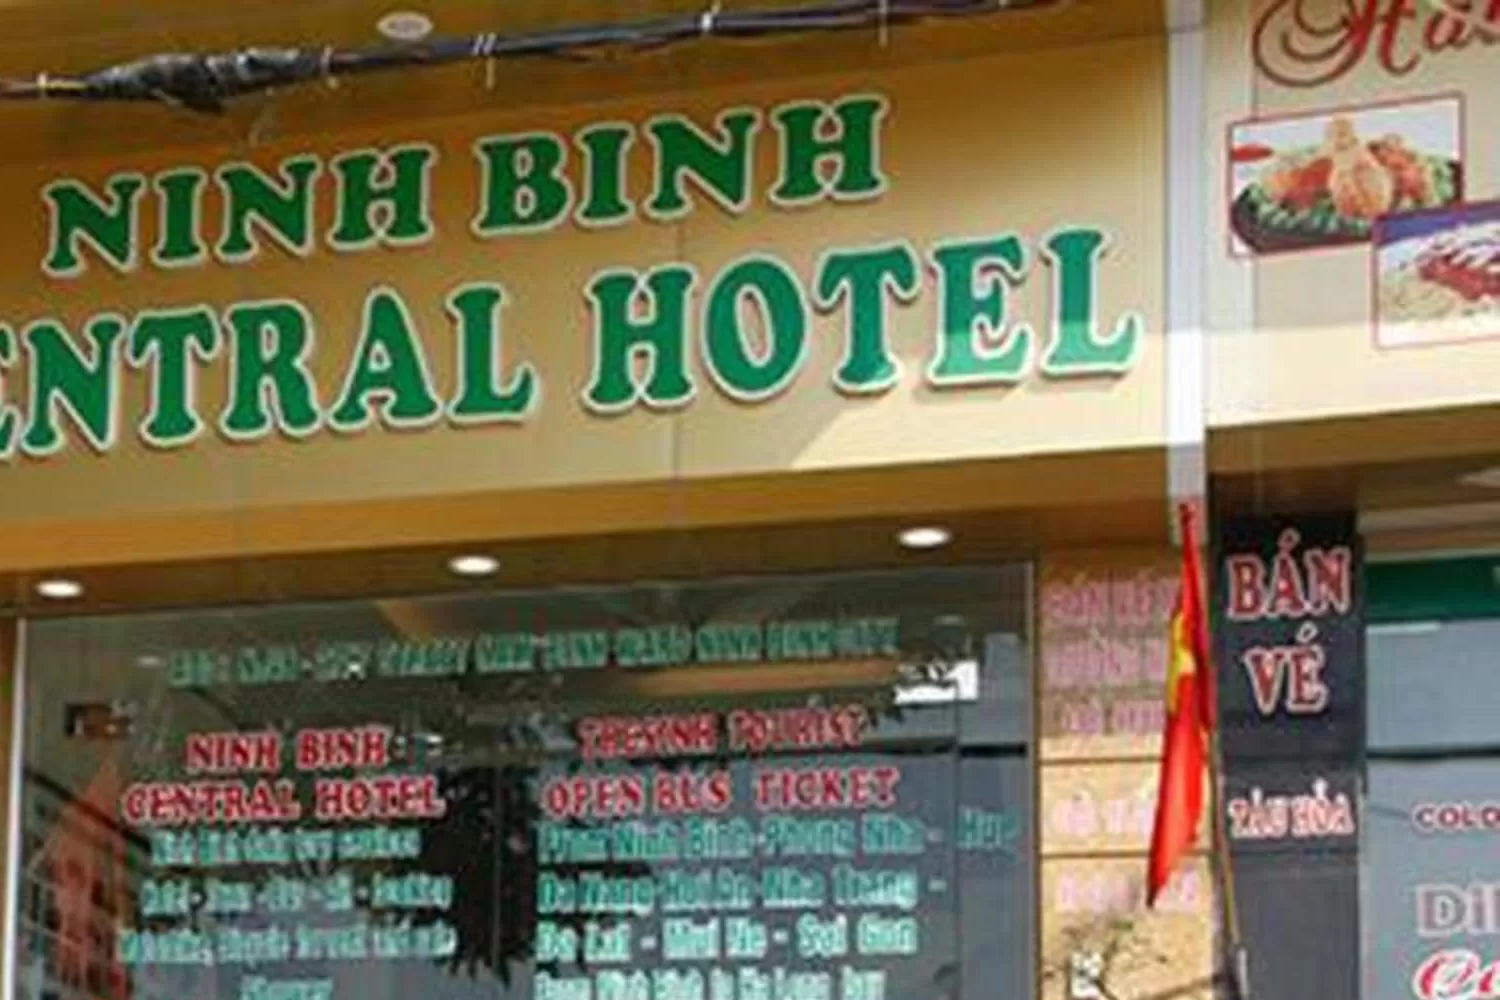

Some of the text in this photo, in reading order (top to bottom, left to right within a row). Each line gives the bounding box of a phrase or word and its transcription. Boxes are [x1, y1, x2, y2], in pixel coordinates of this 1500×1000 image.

[43, 94, 892, 277] NINH BINH
[585, 227, 1145, 412] HOTEL
[184, 726, 391, 771] NINH BINH
[124, 774, 448, 825] CENTRAL HOTEL
[541, 774, 643, 818] OPEN
[755, 764, 900, 809] TICKET
